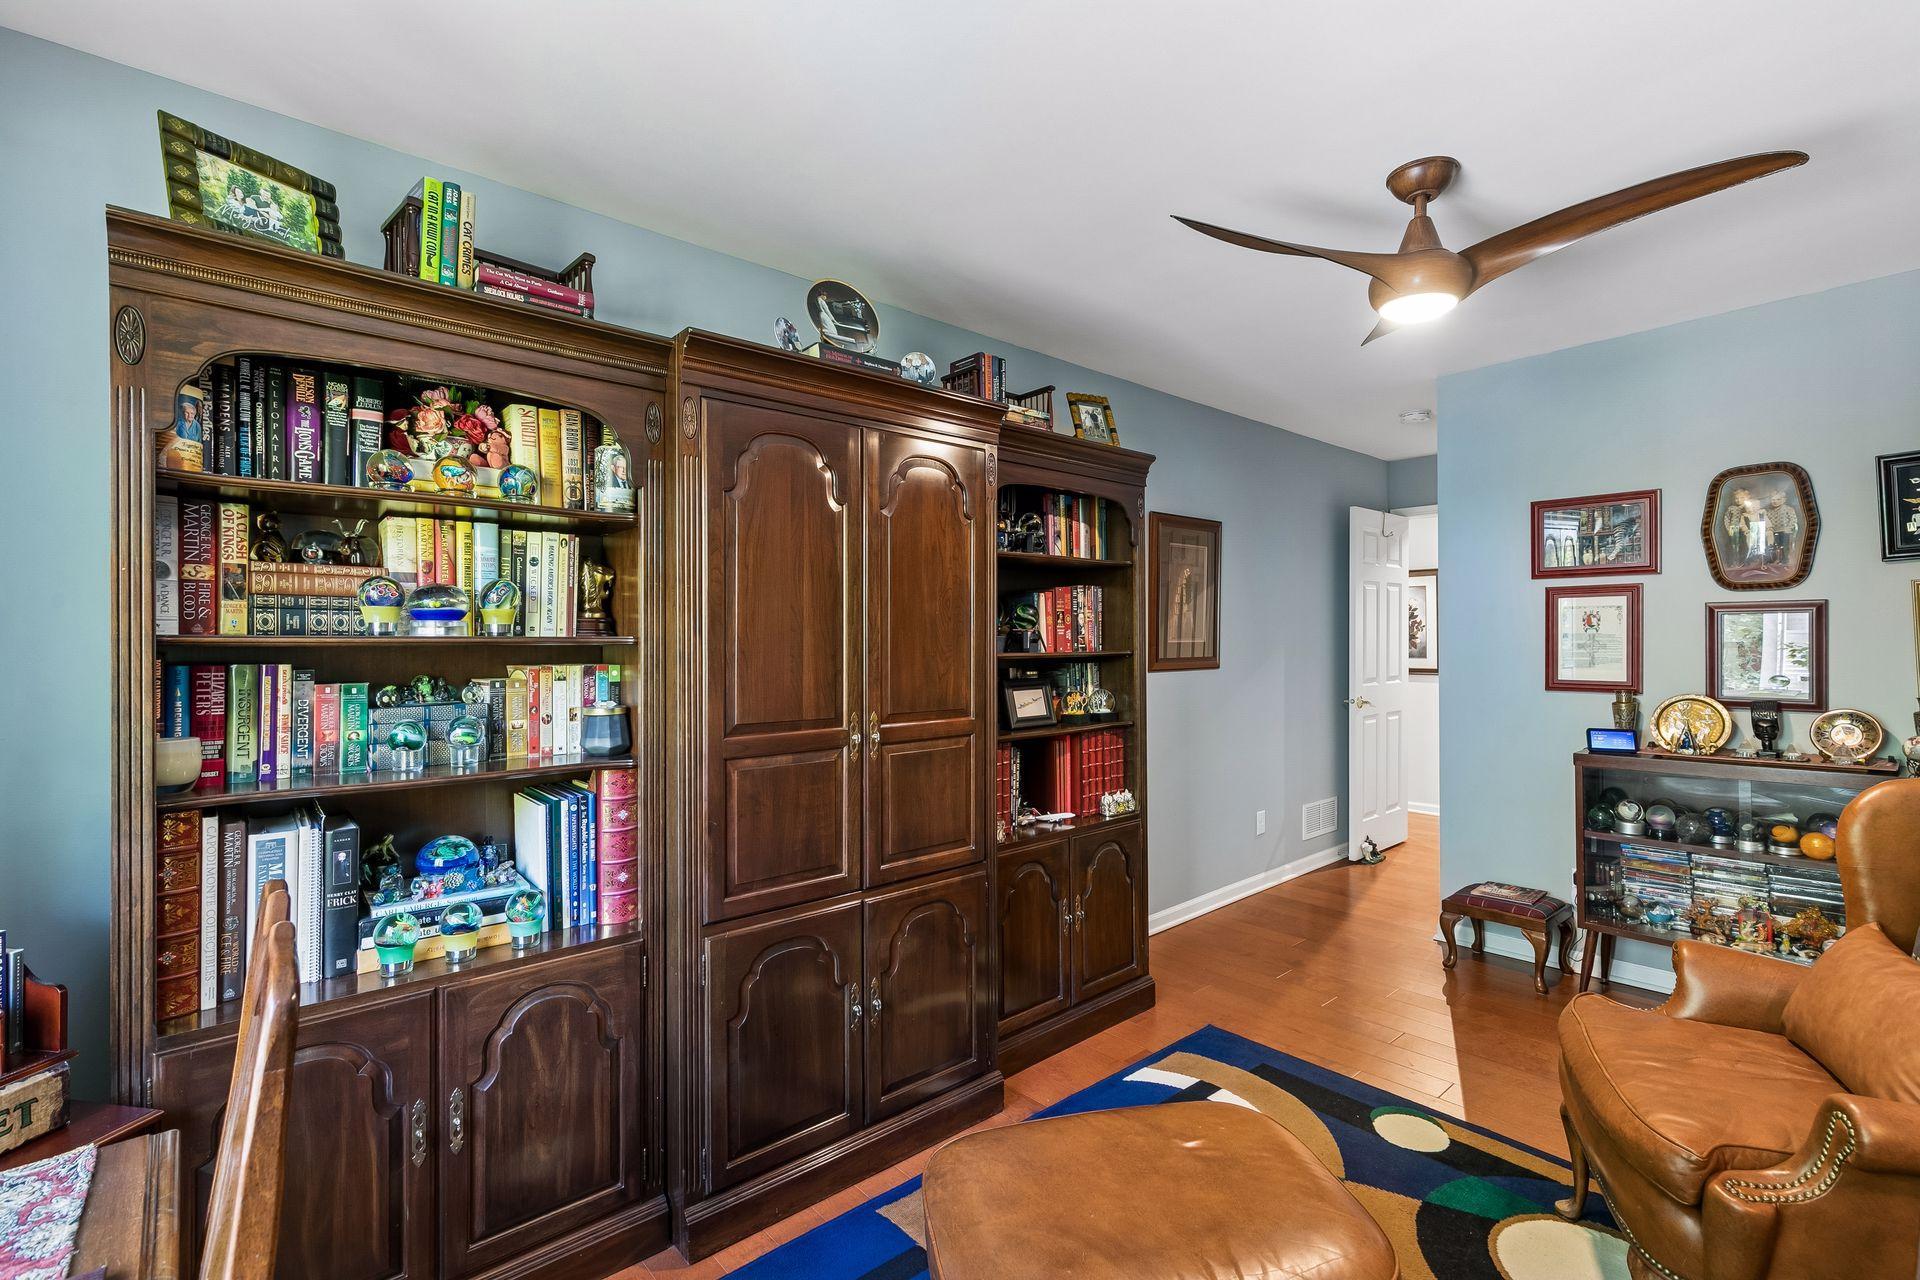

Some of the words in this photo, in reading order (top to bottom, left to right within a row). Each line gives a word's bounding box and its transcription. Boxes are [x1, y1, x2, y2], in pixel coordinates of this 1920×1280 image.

[428, 190, 438, 205] CAT
[214, 202, 252, 231] Merry
[427, 221, 438, 241] KIWI
[462, 221, 473, 239] CAT
[462, 240, 473, 276] CRIMES
[484, 286, 506, 298] SHERLOCK
[506, 290, 525, 302] HOLMES
[305, 375, 314, 404] NELSON
[357, 396, 382, 406] ROBERT
[220, 383, 231, 432] MAIDENS
[240, 392, 251, 422] HAMILTON
[356, 401, 384, 411] LUDLUM
[566, 414, 578, 427] DAN
[566, 428, 578, 452] BROWN
[294, 450, 316, 479] GAME
[200, 504, 212, 544] GEORGE
[222, 508, 234, 526] OF
[236, 510, 248, 520] A
[184, 502, 200, 562] MARTIN
[222, 528, 234, 560] KINGS
[236, 522, 248, 560] CLASH
[441, 554, 449, 582] MANTEL
[160, 590, 170, 614] DANCE
[183, 582, 197, 620] BLOOD
[198, 582, 212, 604] FIRE
[198, 606, 212, 620] &
[196, 672, 212, 716] PETERS
[211, 672, 226, 715] ELIZABETH
[236, 688, 252, 760] INSURGENT
[297, 700, 309, 760] DIVERGENT
[320, 704, 328, 730] MARTIN
[348, 704, 356, 730] MARTIN
[320, 744, 328, 766] CROWS
[224, 832, 234, 868] MARTIN
[234, 830, 242, 854] GEORGE
[206, 826, 216, 906] CAPODIMONTE
[327, 895, 357, 907] FRICK
[204, 908, 216, 983] COLLECTIBLES
[221, 933, 232, 948] ICE
[220, 956, 232, 976] FIRE
